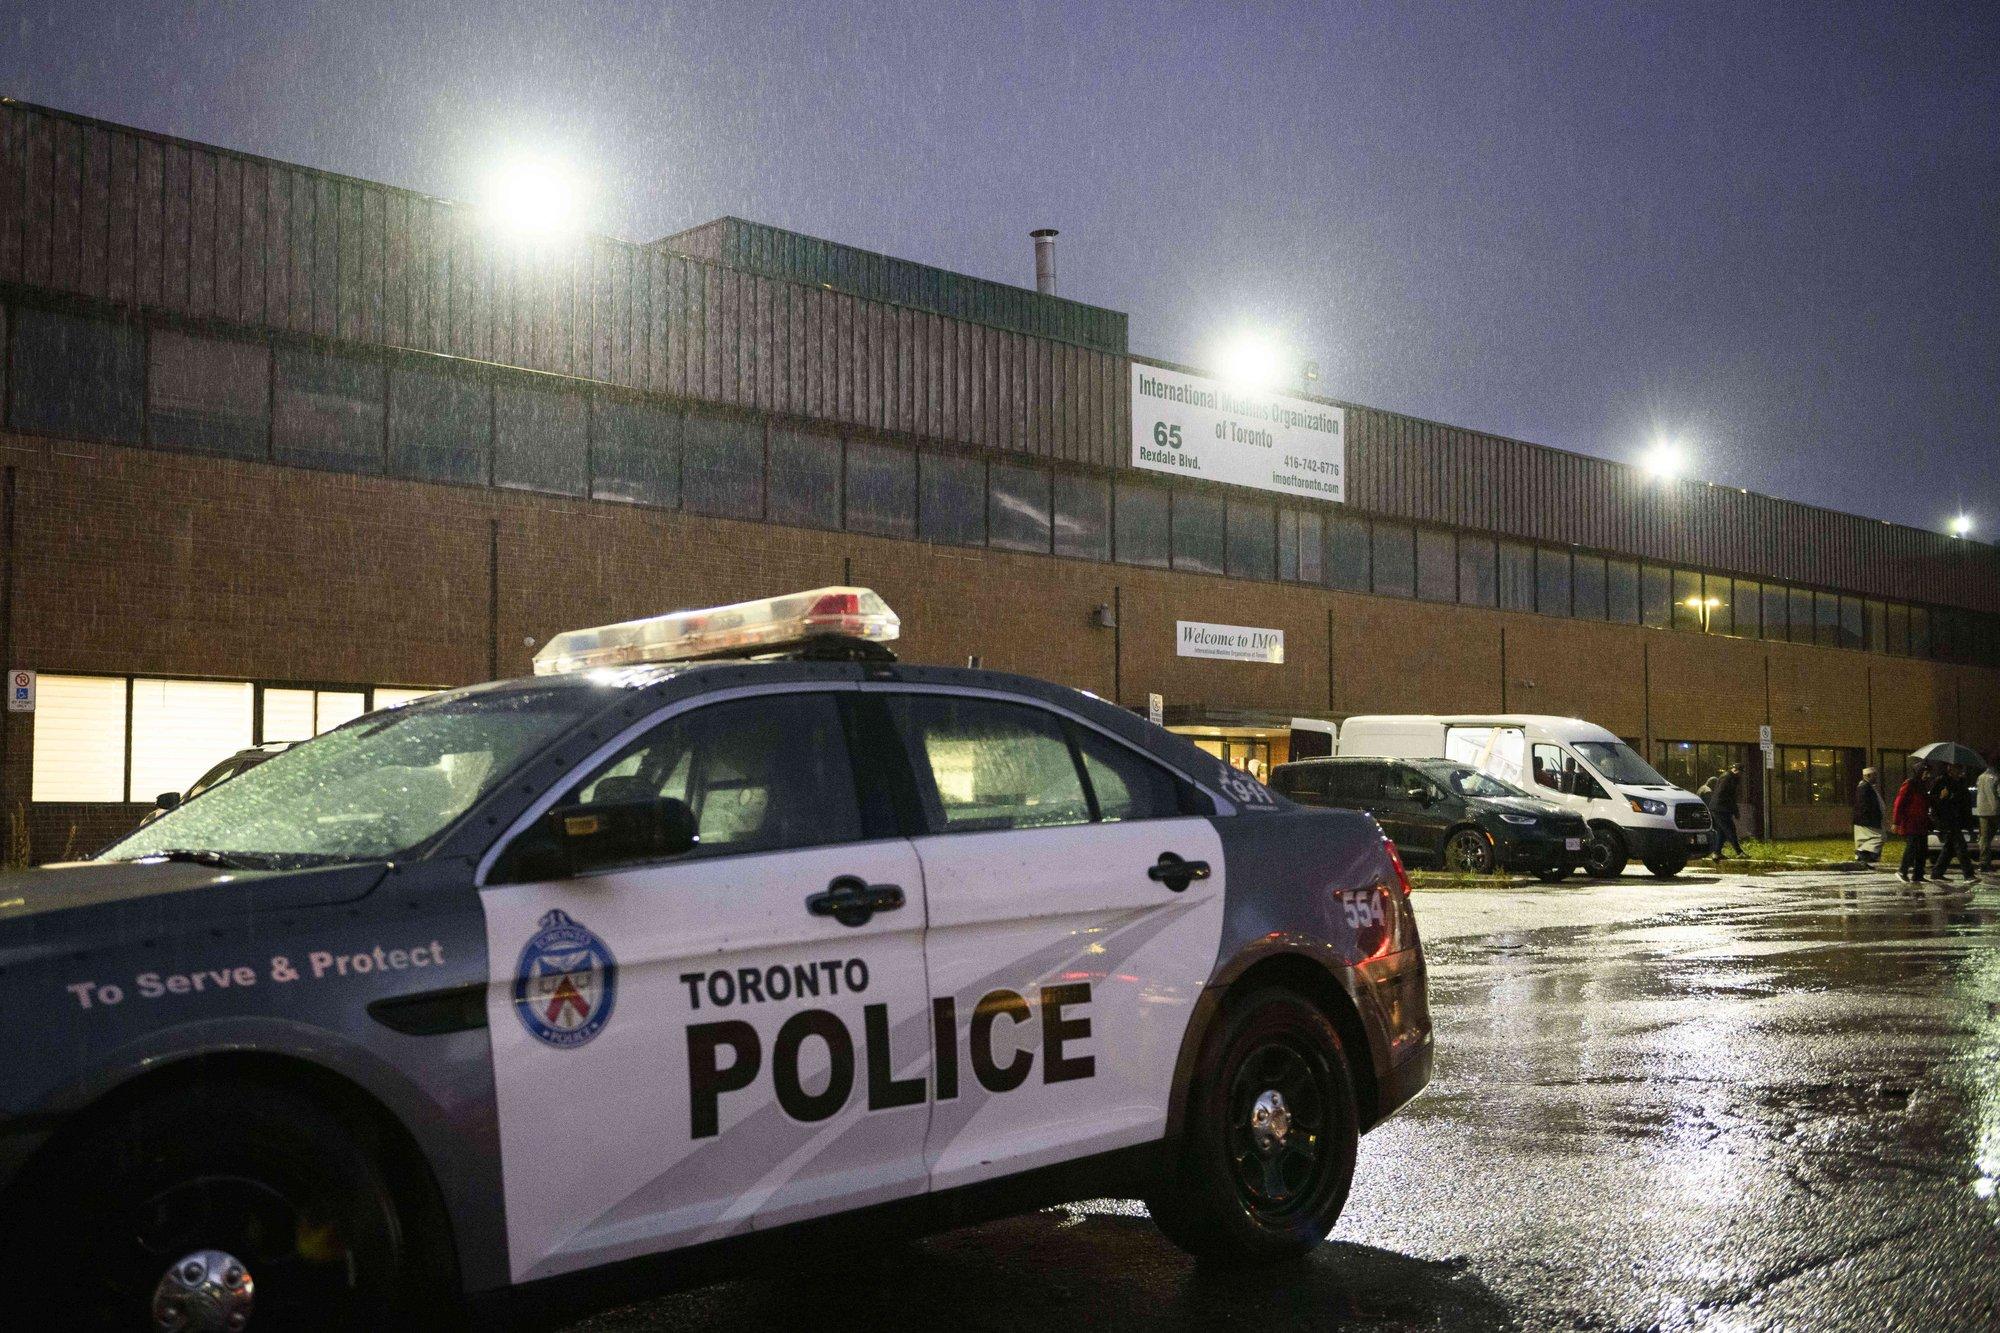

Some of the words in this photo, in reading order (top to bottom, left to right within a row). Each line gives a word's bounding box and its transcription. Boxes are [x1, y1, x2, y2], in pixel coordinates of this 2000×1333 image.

[1139, 373, 1218, 410] International
[1272, 403, 1339, 435] Organization
[1153, 421, 1183, 449] 65
[1215, 420, 1227, 440] of
[1230, 422, 1273, 449] Toronto
[1139, 446, 1176, 466] Rexdale
[1179, 454, 1201, 470] Blvd.
[1284, 455, 1339, 476] 416-742-6776
[1184, 627, 1235, 647] Welcome
[1237, 634, 1248, 647] to
[1251, 632, 1278, 650] IMO
[67, 981, 124, 1009] To
[135, 966, 257, 998] Serve
[270, 955, 300, 983] &
[308, 940, 445, 978] Protect
[679, 957, 870, 1010] TORONTO
[685, 982, 1096, 1140] POLICE
